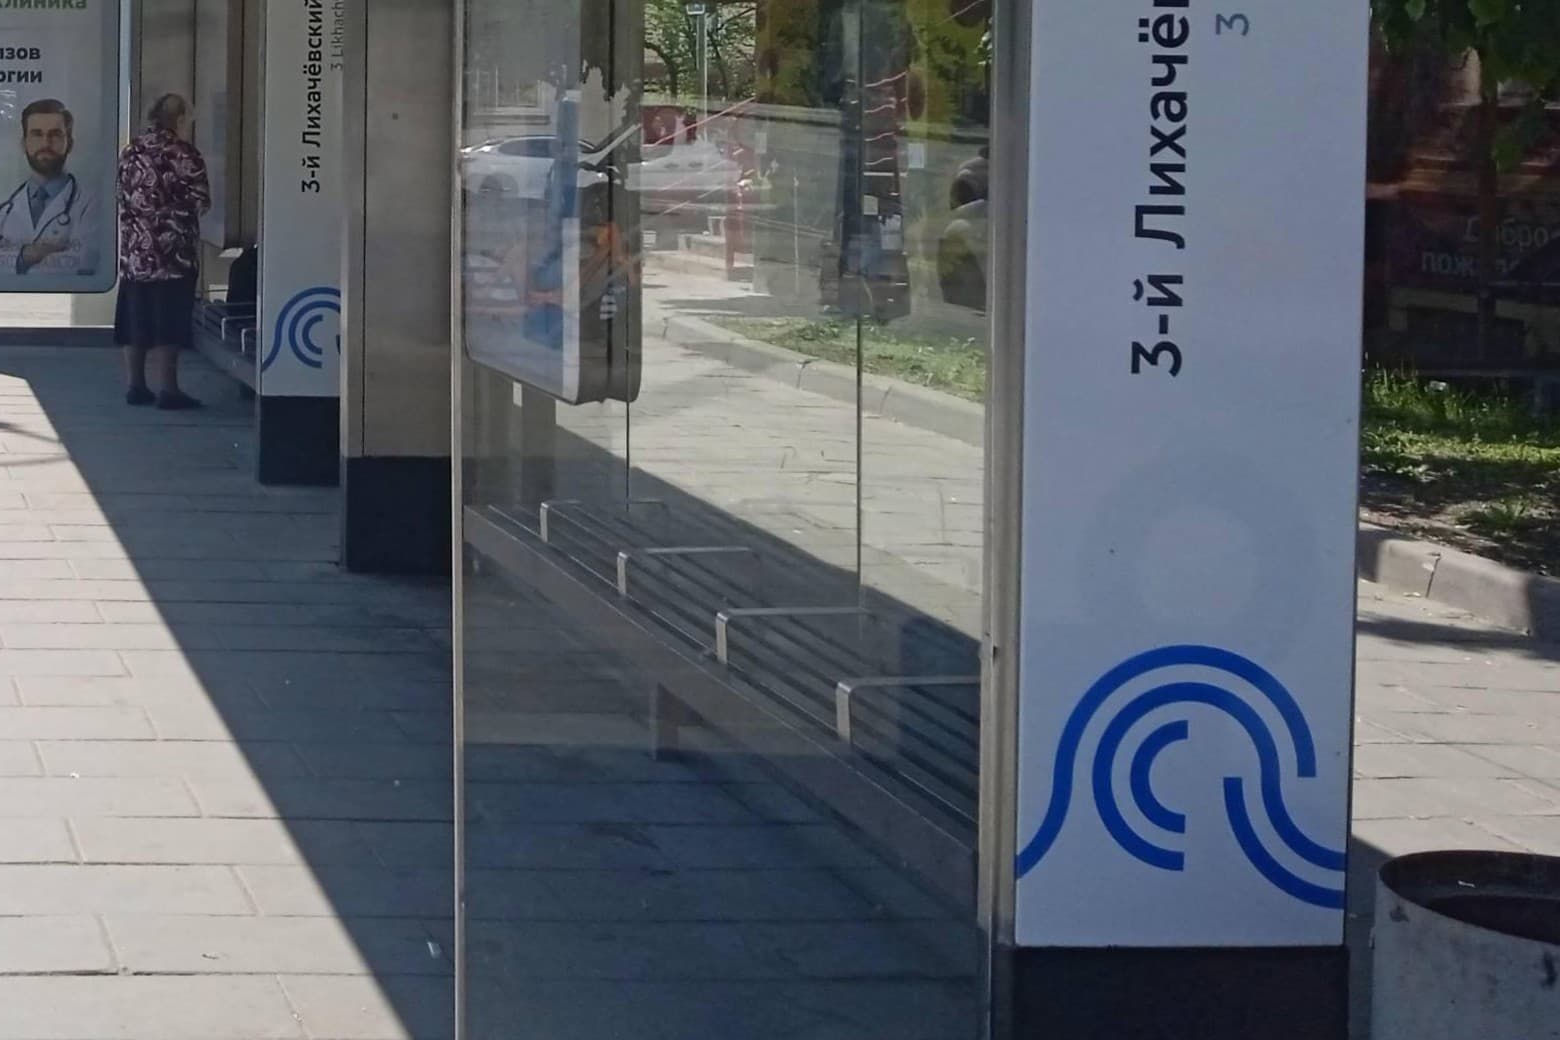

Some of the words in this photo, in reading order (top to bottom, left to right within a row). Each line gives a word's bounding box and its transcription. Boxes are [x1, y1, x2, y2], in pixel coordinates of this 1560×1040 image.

[1215, 11, 1251, 37] 3
[301, 155, 321, 194] 3-й
[1131, 272, 1186, 378] 3-й
